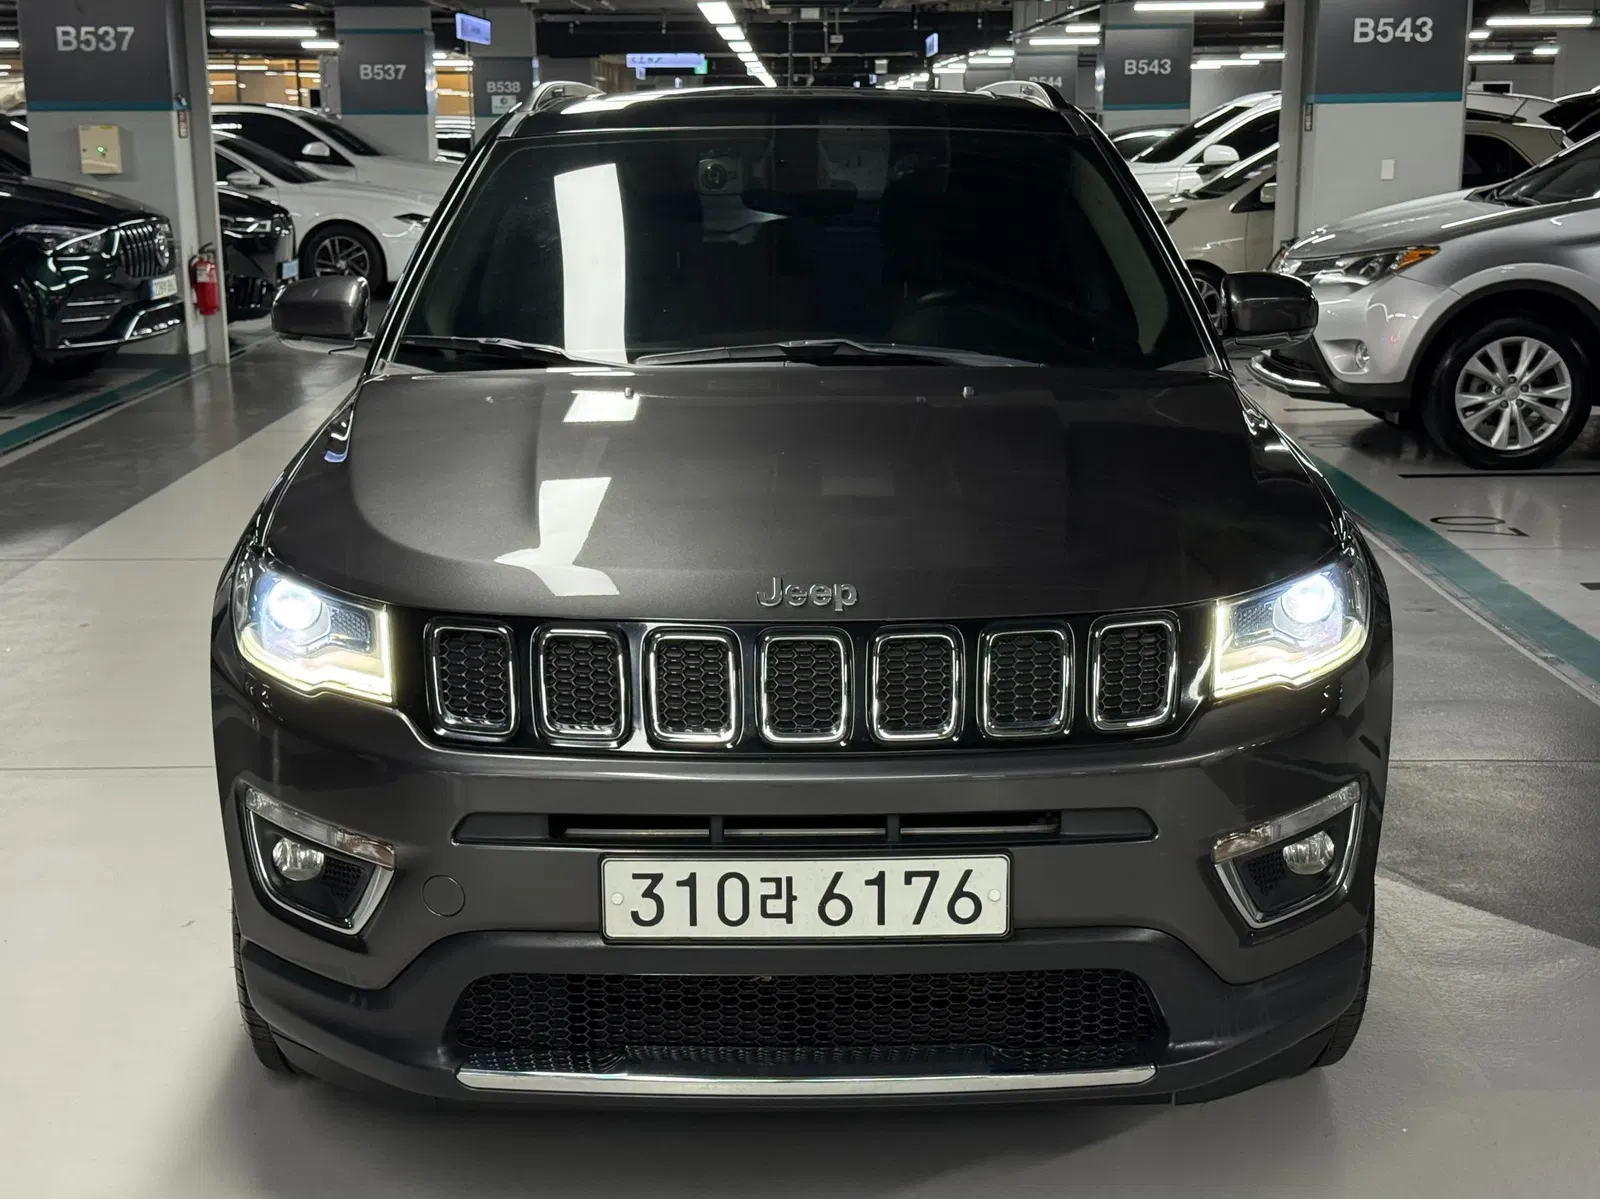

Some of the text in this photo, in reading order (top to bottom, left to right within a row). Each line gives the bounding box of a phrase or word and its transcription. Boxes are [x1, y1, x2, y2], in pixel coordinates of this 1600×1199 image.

[55, 25, 135, 52] B537
[1353, 16, 1434, 43] B543
[359, 63, 407, 80] B537
[1124, 58, 1172, 75] B543
[486, 81, 521, 93] B538
[756, 576, 858, 612] Jeep
[630, 868, 983, 927] 310라 6176
